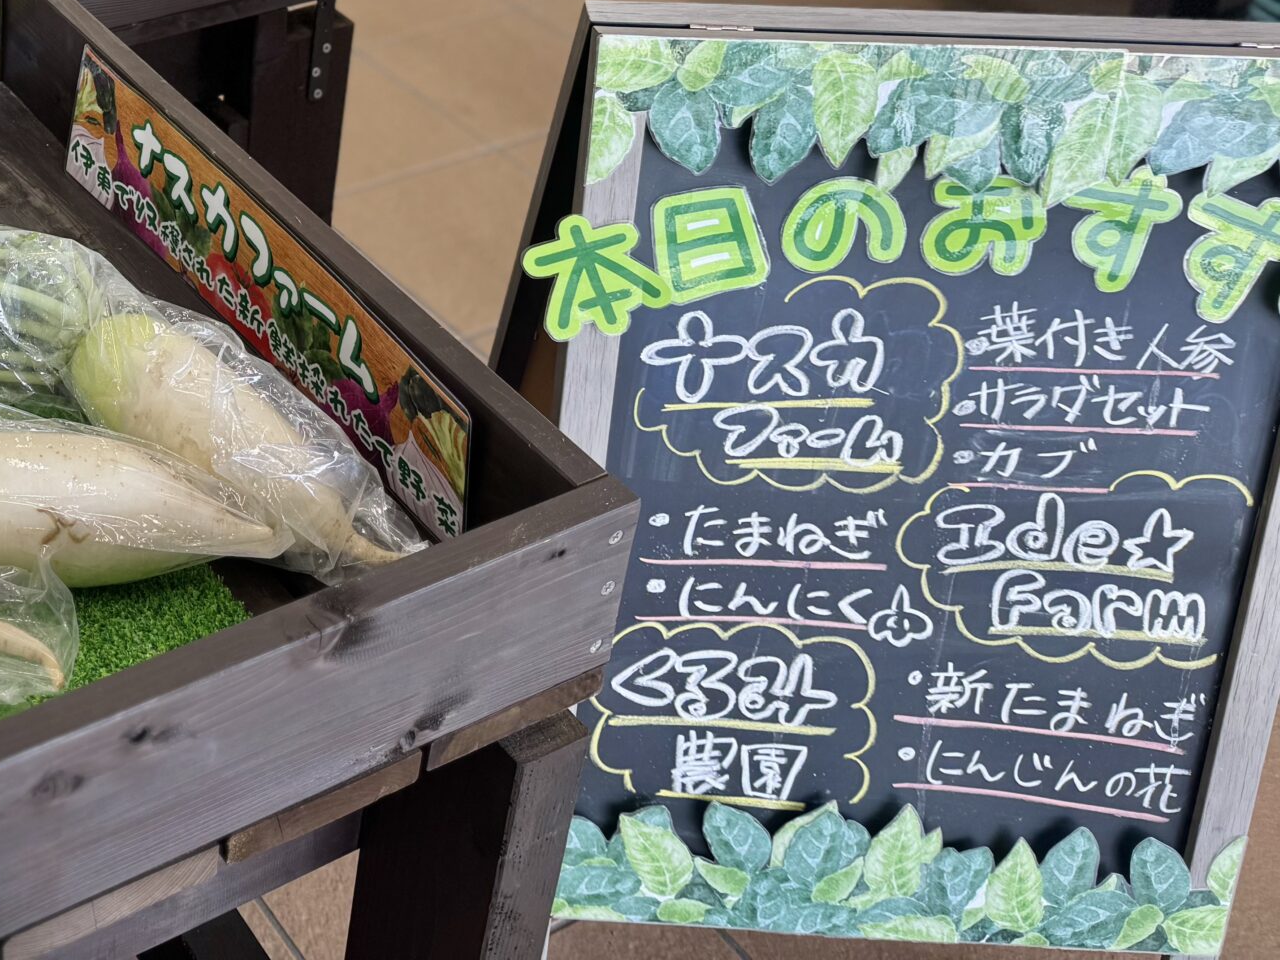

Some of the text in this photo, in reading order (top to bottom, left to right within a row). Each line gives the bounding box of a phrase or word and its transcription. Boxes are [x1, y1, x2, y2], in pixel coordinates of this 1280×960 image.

[131, 120, 380, 403] ナスカファーム
[640, 308, 885, 403] ナスカ
[976, 301, 1236, 379] 葉付き人参
[713, 404, 904, 467] ファーム
[968, 375, 1210, 428] サラダセット
[979, 438, 1097, 478] カブ
[685, 504, 887, 561] たまねぎ
[678, 578, 872, 624] にんにく
[991, 568, 1206, 642] Farm
[925, 661, 1206, 741] 新たまねぎ
[671, 730, 808, 800] 農園
[925, 740, 1192, 814] にんじんの花
